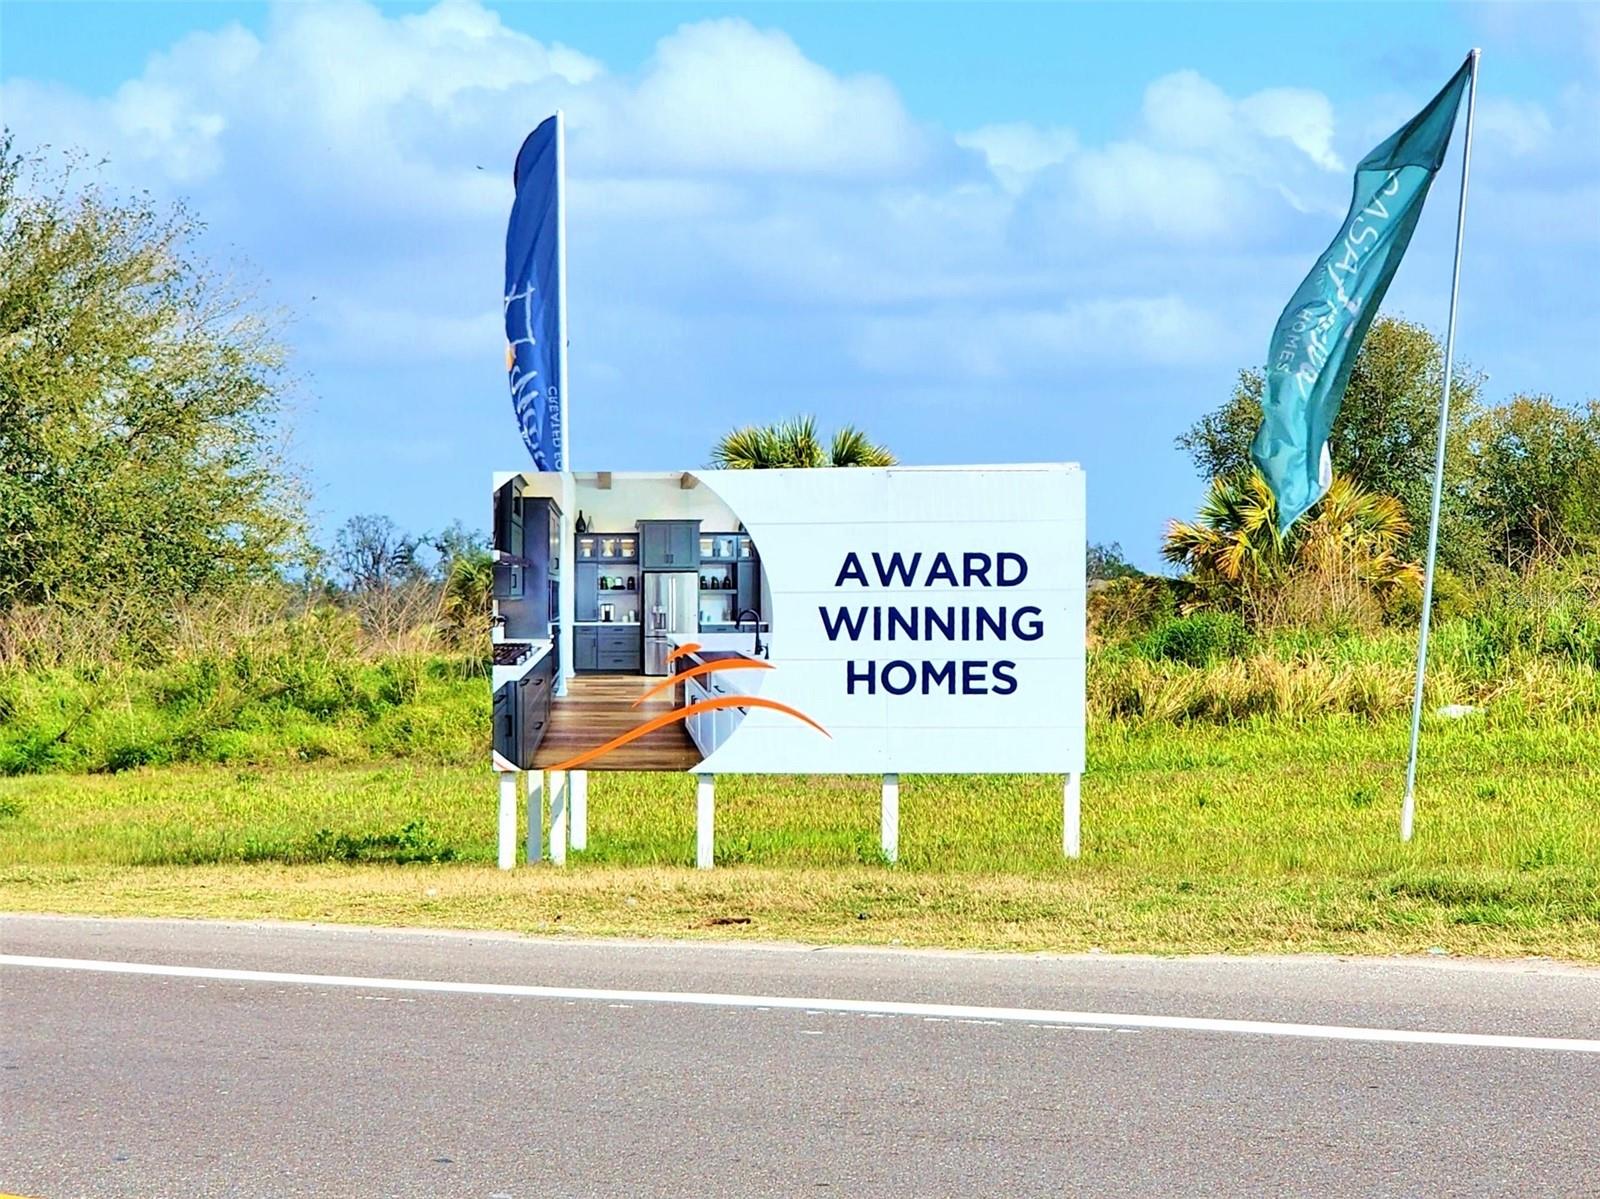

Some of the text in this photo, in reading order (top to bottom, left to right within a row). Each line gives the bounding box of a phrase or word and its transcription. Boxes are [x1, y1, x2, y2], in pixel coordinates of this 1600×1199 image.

[1276, 309, 1313, 373] HOMES
[835, 552, 1028, 587] AWARD
[818, 606, 1044, 641] WINNING
[847, 660, 1018, 695] HOMES
